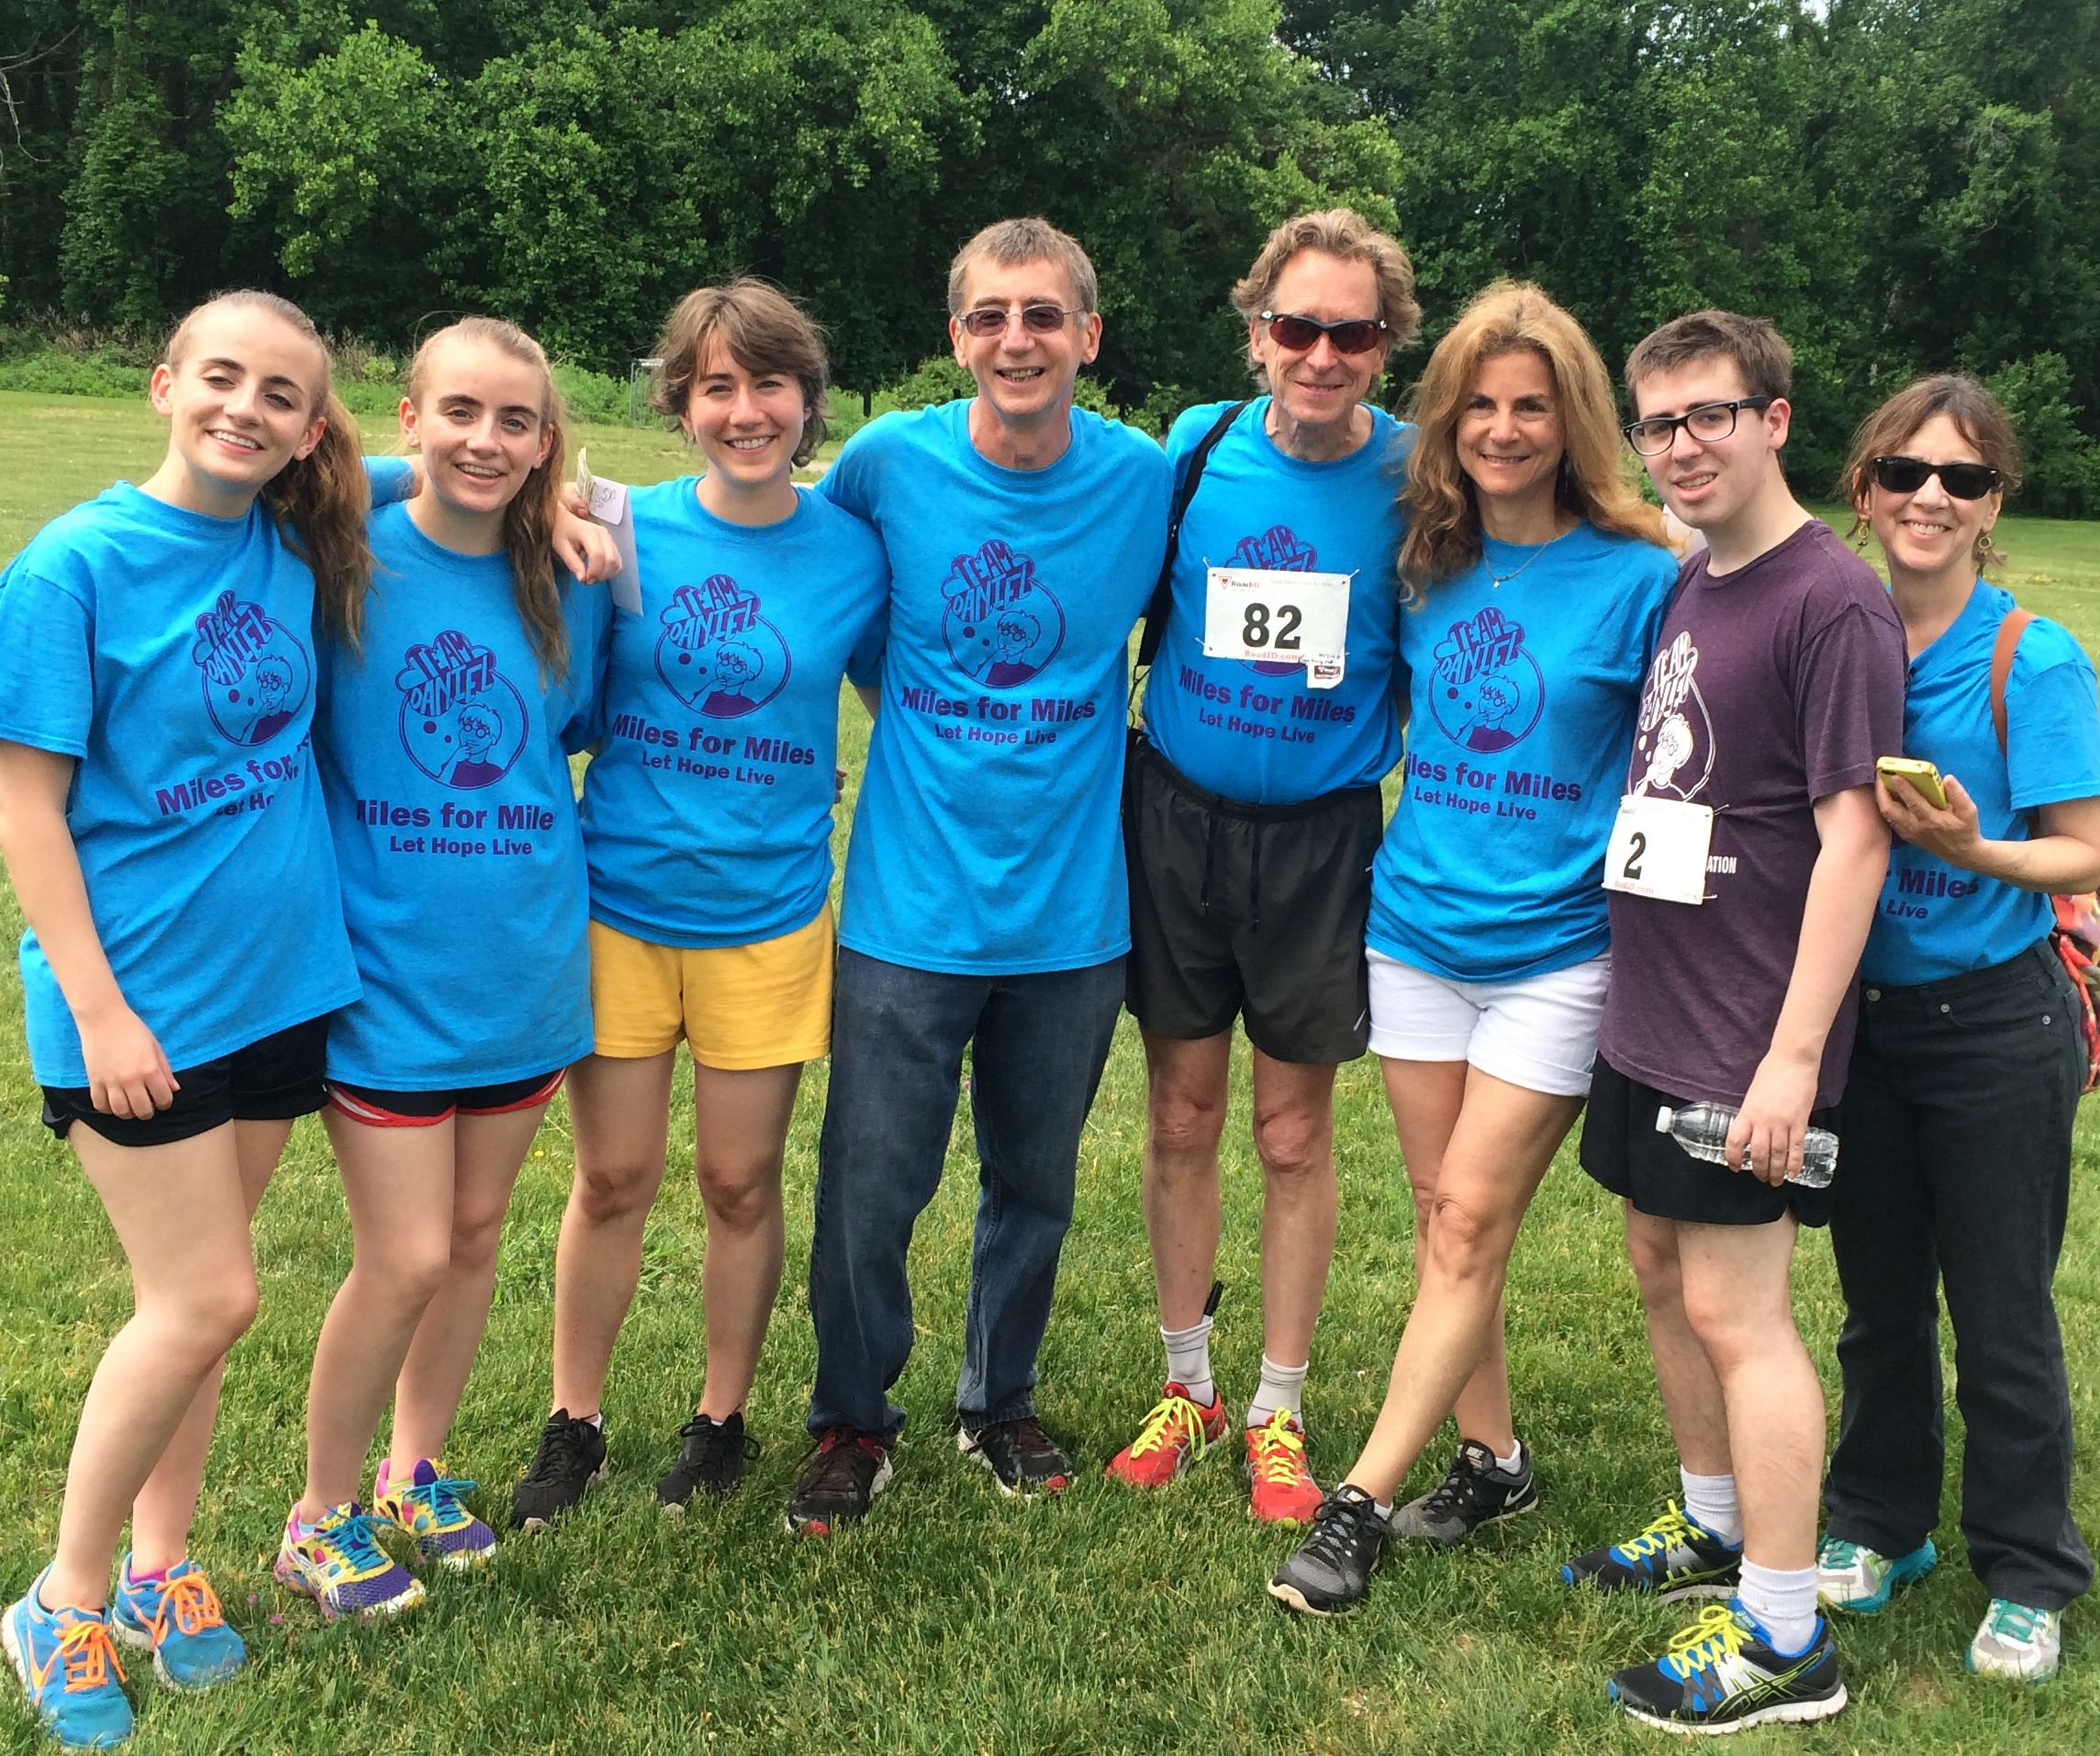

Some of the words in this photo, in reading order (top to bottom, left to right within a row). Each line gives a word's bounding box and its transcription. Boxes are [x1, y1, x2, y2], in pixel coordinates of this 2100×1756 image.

[952, 542, 1015, 586] TEAM
[1239, 528, 1296, 568] TEAM
[675, 576, 739, 618] TEAM
[952, 564, 1031, 622] DANIEL
[206, 610, 274, 683] DANIEL
[670, 601, 755, 650] DANIEL
[1242, 602, 1301, 651] 82
[1449, 609, 1505, 652] TEAM
[408, 632, 473, 678] TEAM
[1439, 631, 1518, 684] DANIEL
[409, 654, 495, 716] DANIEL
[900, 686, 969, 719] Miles
[977, 696, 1022, 721] for
[1031, 698, 1096, 722] Miles
[1179, 664, 1232, 705] Miles
[1240, 684, 1284, 715] for
[1290, 695, 1356, 723] Miles
[612, 712, 679, 748] Miles
[689, 727, 736, 755] for
[743, 735, 816, 766] Miles
[934, 723, 963, 740] Let
[967, 726, 1019, 745] Hope
[1025, 729, 1057, 745] Live
[1199, 707, 1224, 726] Let
[1227, 715, 1277, 739] Hope
[1280, 725, 1315, 744] Live
[154, 772, 246, 816] Miles
[246, 754, 292, 783] for
[642, 750, 673, 769] Let
[677, 757, 731, 779] Hope
[735, 766, 776, 786] Live
[1456, 761, 1498, 790] for
[1504, 769, 1582, 802] Miles
[441, 801, 487, 828] for
[497, 804, 557, 831] Mile
[1413, 786, 1441, 805] Let
[1446, 792, 1491, 815] Hope
[1496, 800, 1537, 821] Live
[389, 835, 426, 855] Let
[431, 837, 486, 857] Hope
[493, 838, 532, 856] Live
[1623, 831, 1647, 880] 2
[1885, 899, 1929, 919] Live
